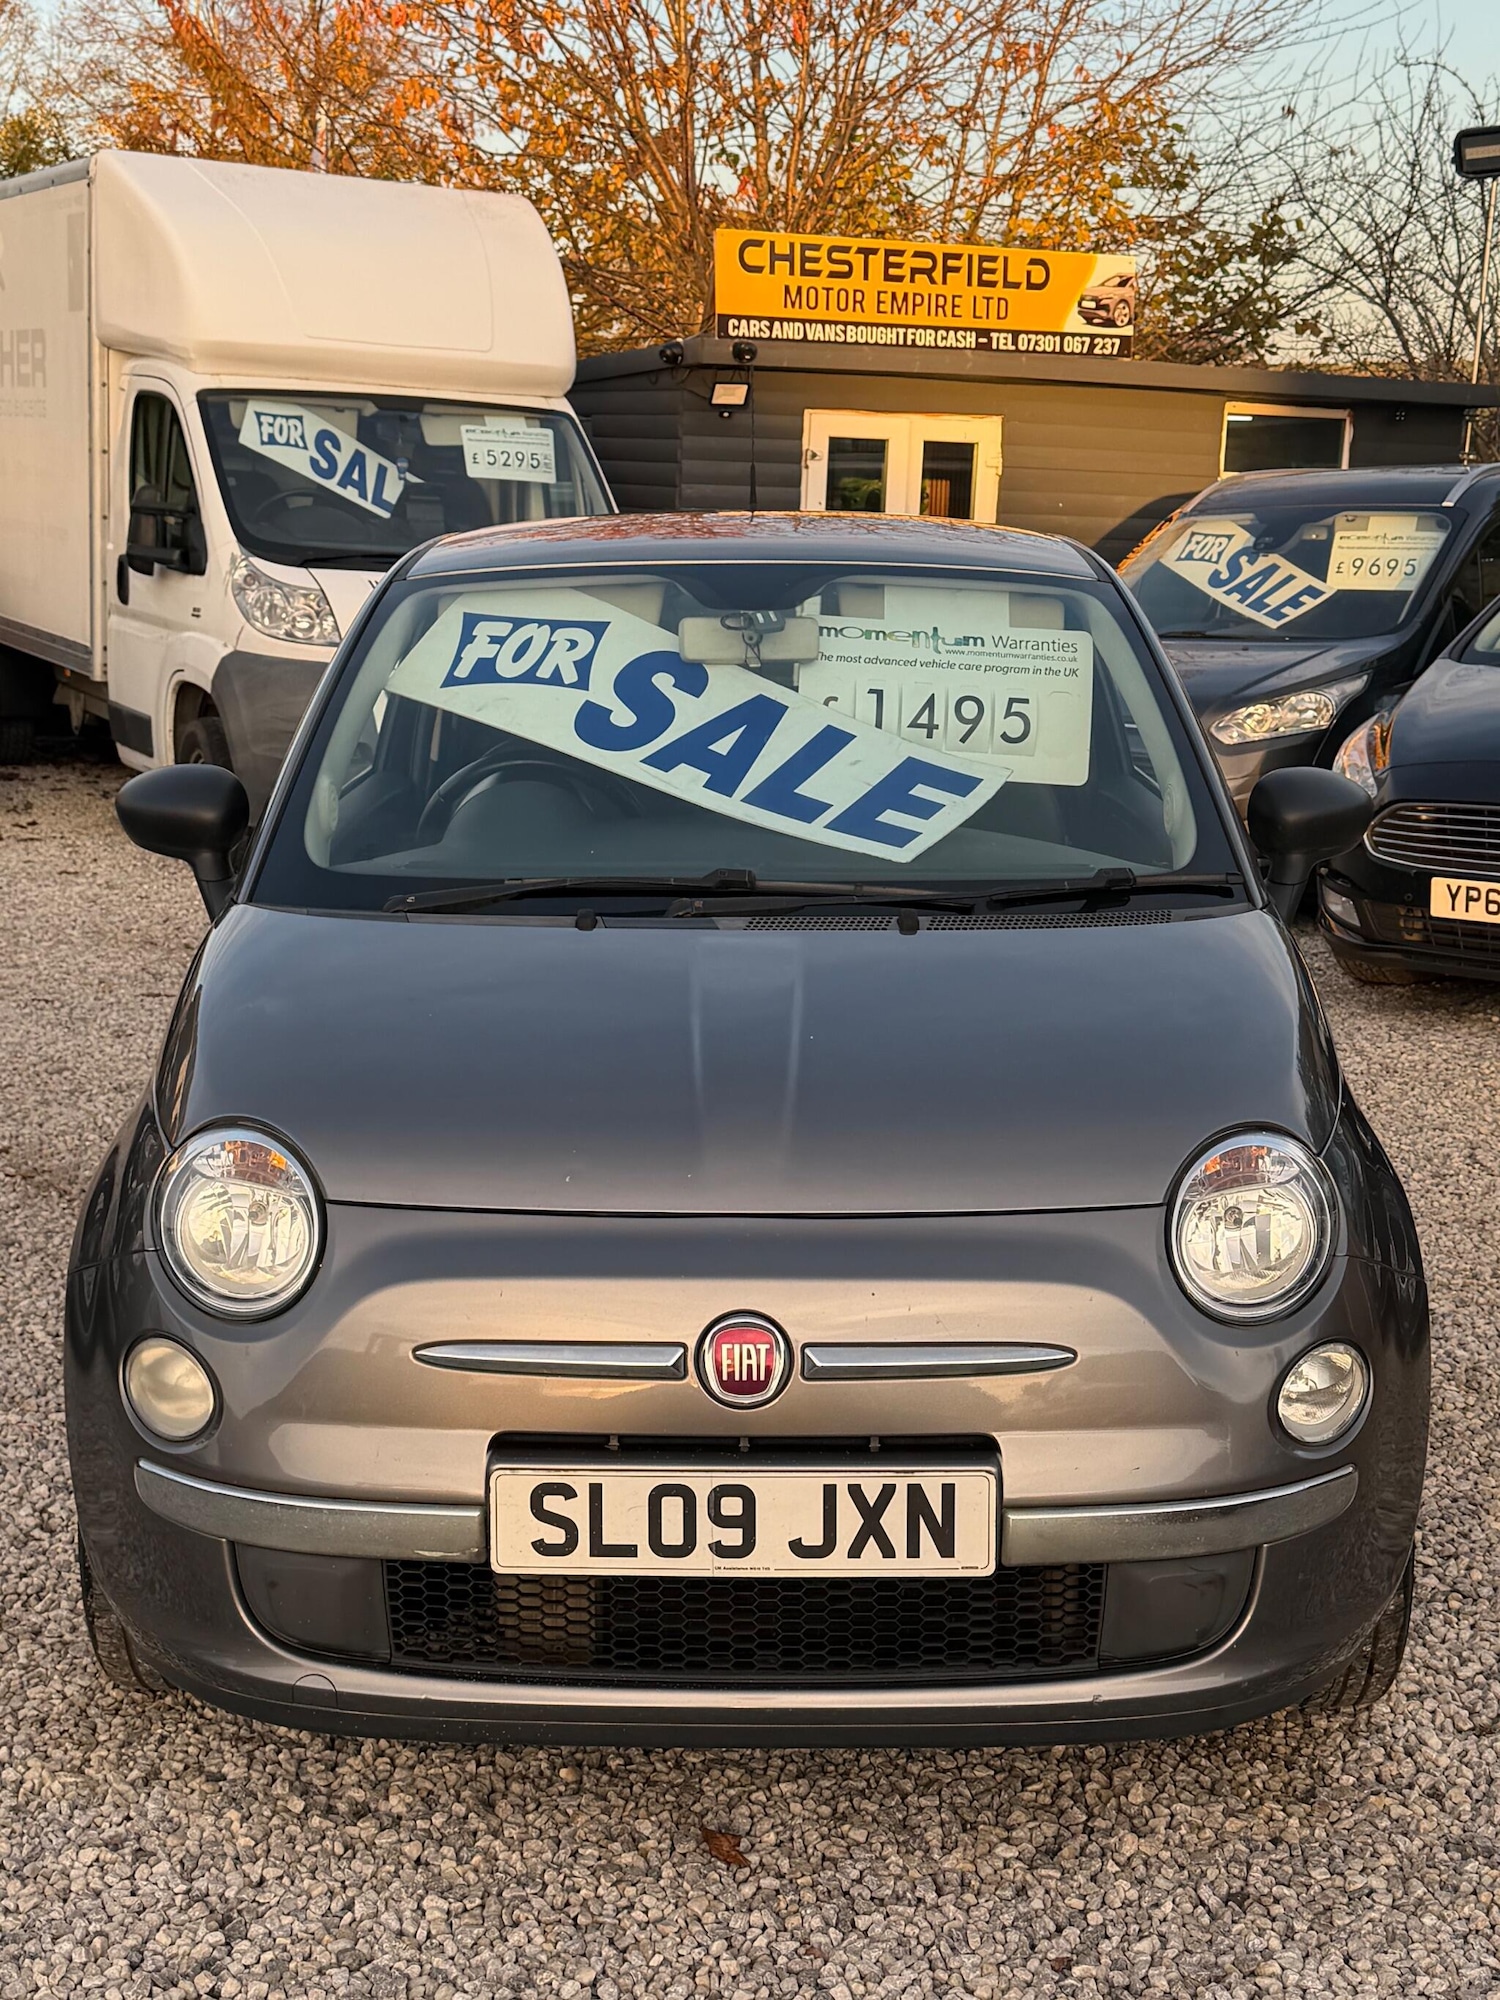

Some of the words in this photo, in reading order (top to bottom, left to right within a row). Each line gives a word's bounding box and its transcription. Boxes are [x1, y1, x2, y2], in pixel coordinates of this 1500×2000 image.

[738, 239, 1050, 290] CHESTERFIELD
[784, 285, 865, 313] MOTOR
[876, 289, 963, 318] EMPIRE
[973, 295, 1009, 320] LTD
[728, 318, 770, 339] CARS
[771, 320, 804, 341] AND
[805, 322, 845, 343] VANS
[846, 325, 906, 346] BOUGHT
[907, 328, 936, 347] FOR
[936, 330, 976, 349] CASH
[990, 332, 1016, 350] TEL
[1018, 334, 1060, 353] 07301
[1063, 336, 1090, 354] 067
[1093, 337, 1120, 355] 237
[259, 414, 305, 448] FOR
[1180, 534, 1230, 562] FOR
[1208, 546, 1327, 622] SALE
[453, 621, 597, 690] FOR
[945, 648, 1079, 663] www.momentumwarranties.co.uk
[991, 635, 1079, 654] Warranties
[836, 654, 862, 664] most
[863, 655, 918, 668] advanced
[919, 659, 957, 670] vehicle
[958, 661, 983, 671] care
[984, 664, 1030, 676] program
[1033, 665, 1042, 675] in
[1044, 666, 1062, 677] the
[1063, 667, 1080, 678] UK
[574, 650, 984, 850] SALE
[1446, 883, 1500, 916] YP6
[721, 1343, 771, 1381] FIAT
[529, 1482, 757, 1559] SL09
[787, 1482, 956, 1559] JXN
